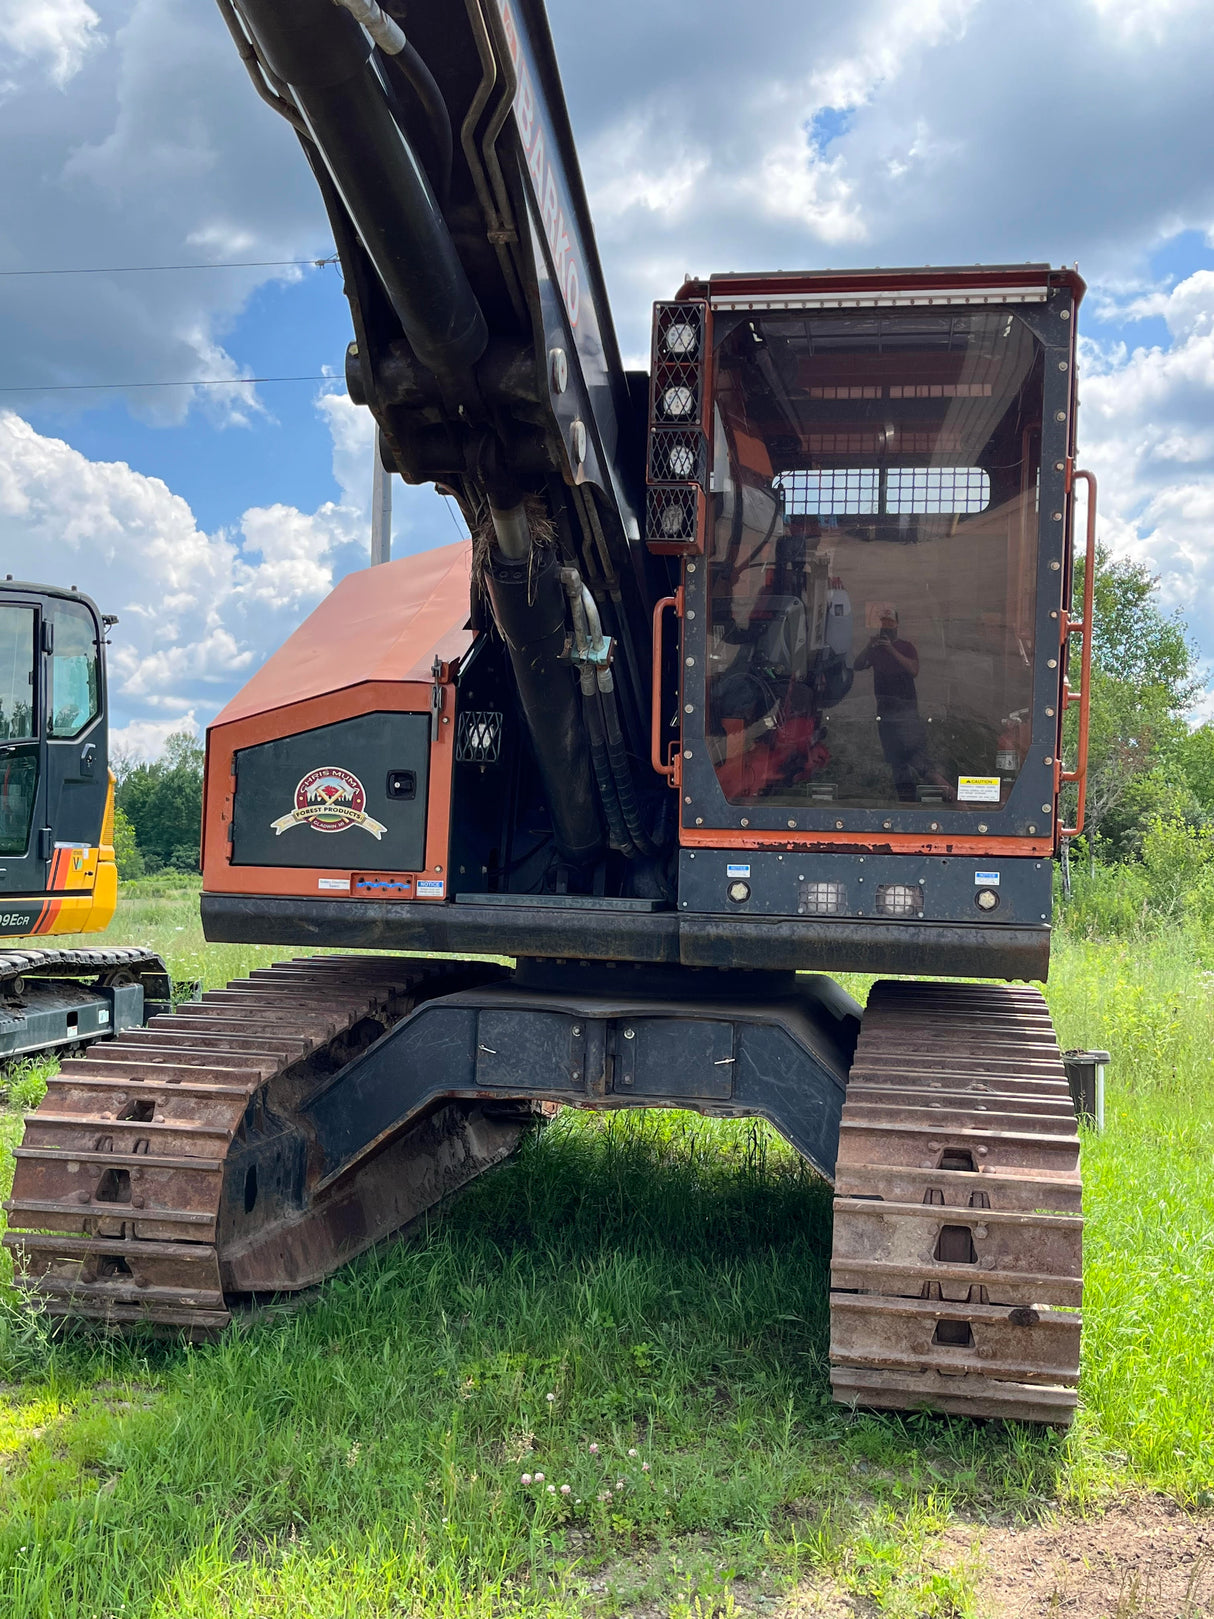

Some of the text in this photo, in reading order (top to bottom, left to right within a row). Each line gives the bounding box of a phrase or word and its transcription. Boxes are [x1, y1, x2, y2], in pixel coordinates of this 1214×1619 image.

[512, 60, 580, 327] BARKO
[300, 770, 361, 795] CHRIS MUMA
[295, 807, 362, 820] FOREST PRODUCTS
[0, 914, 30, 927] 9ECR
